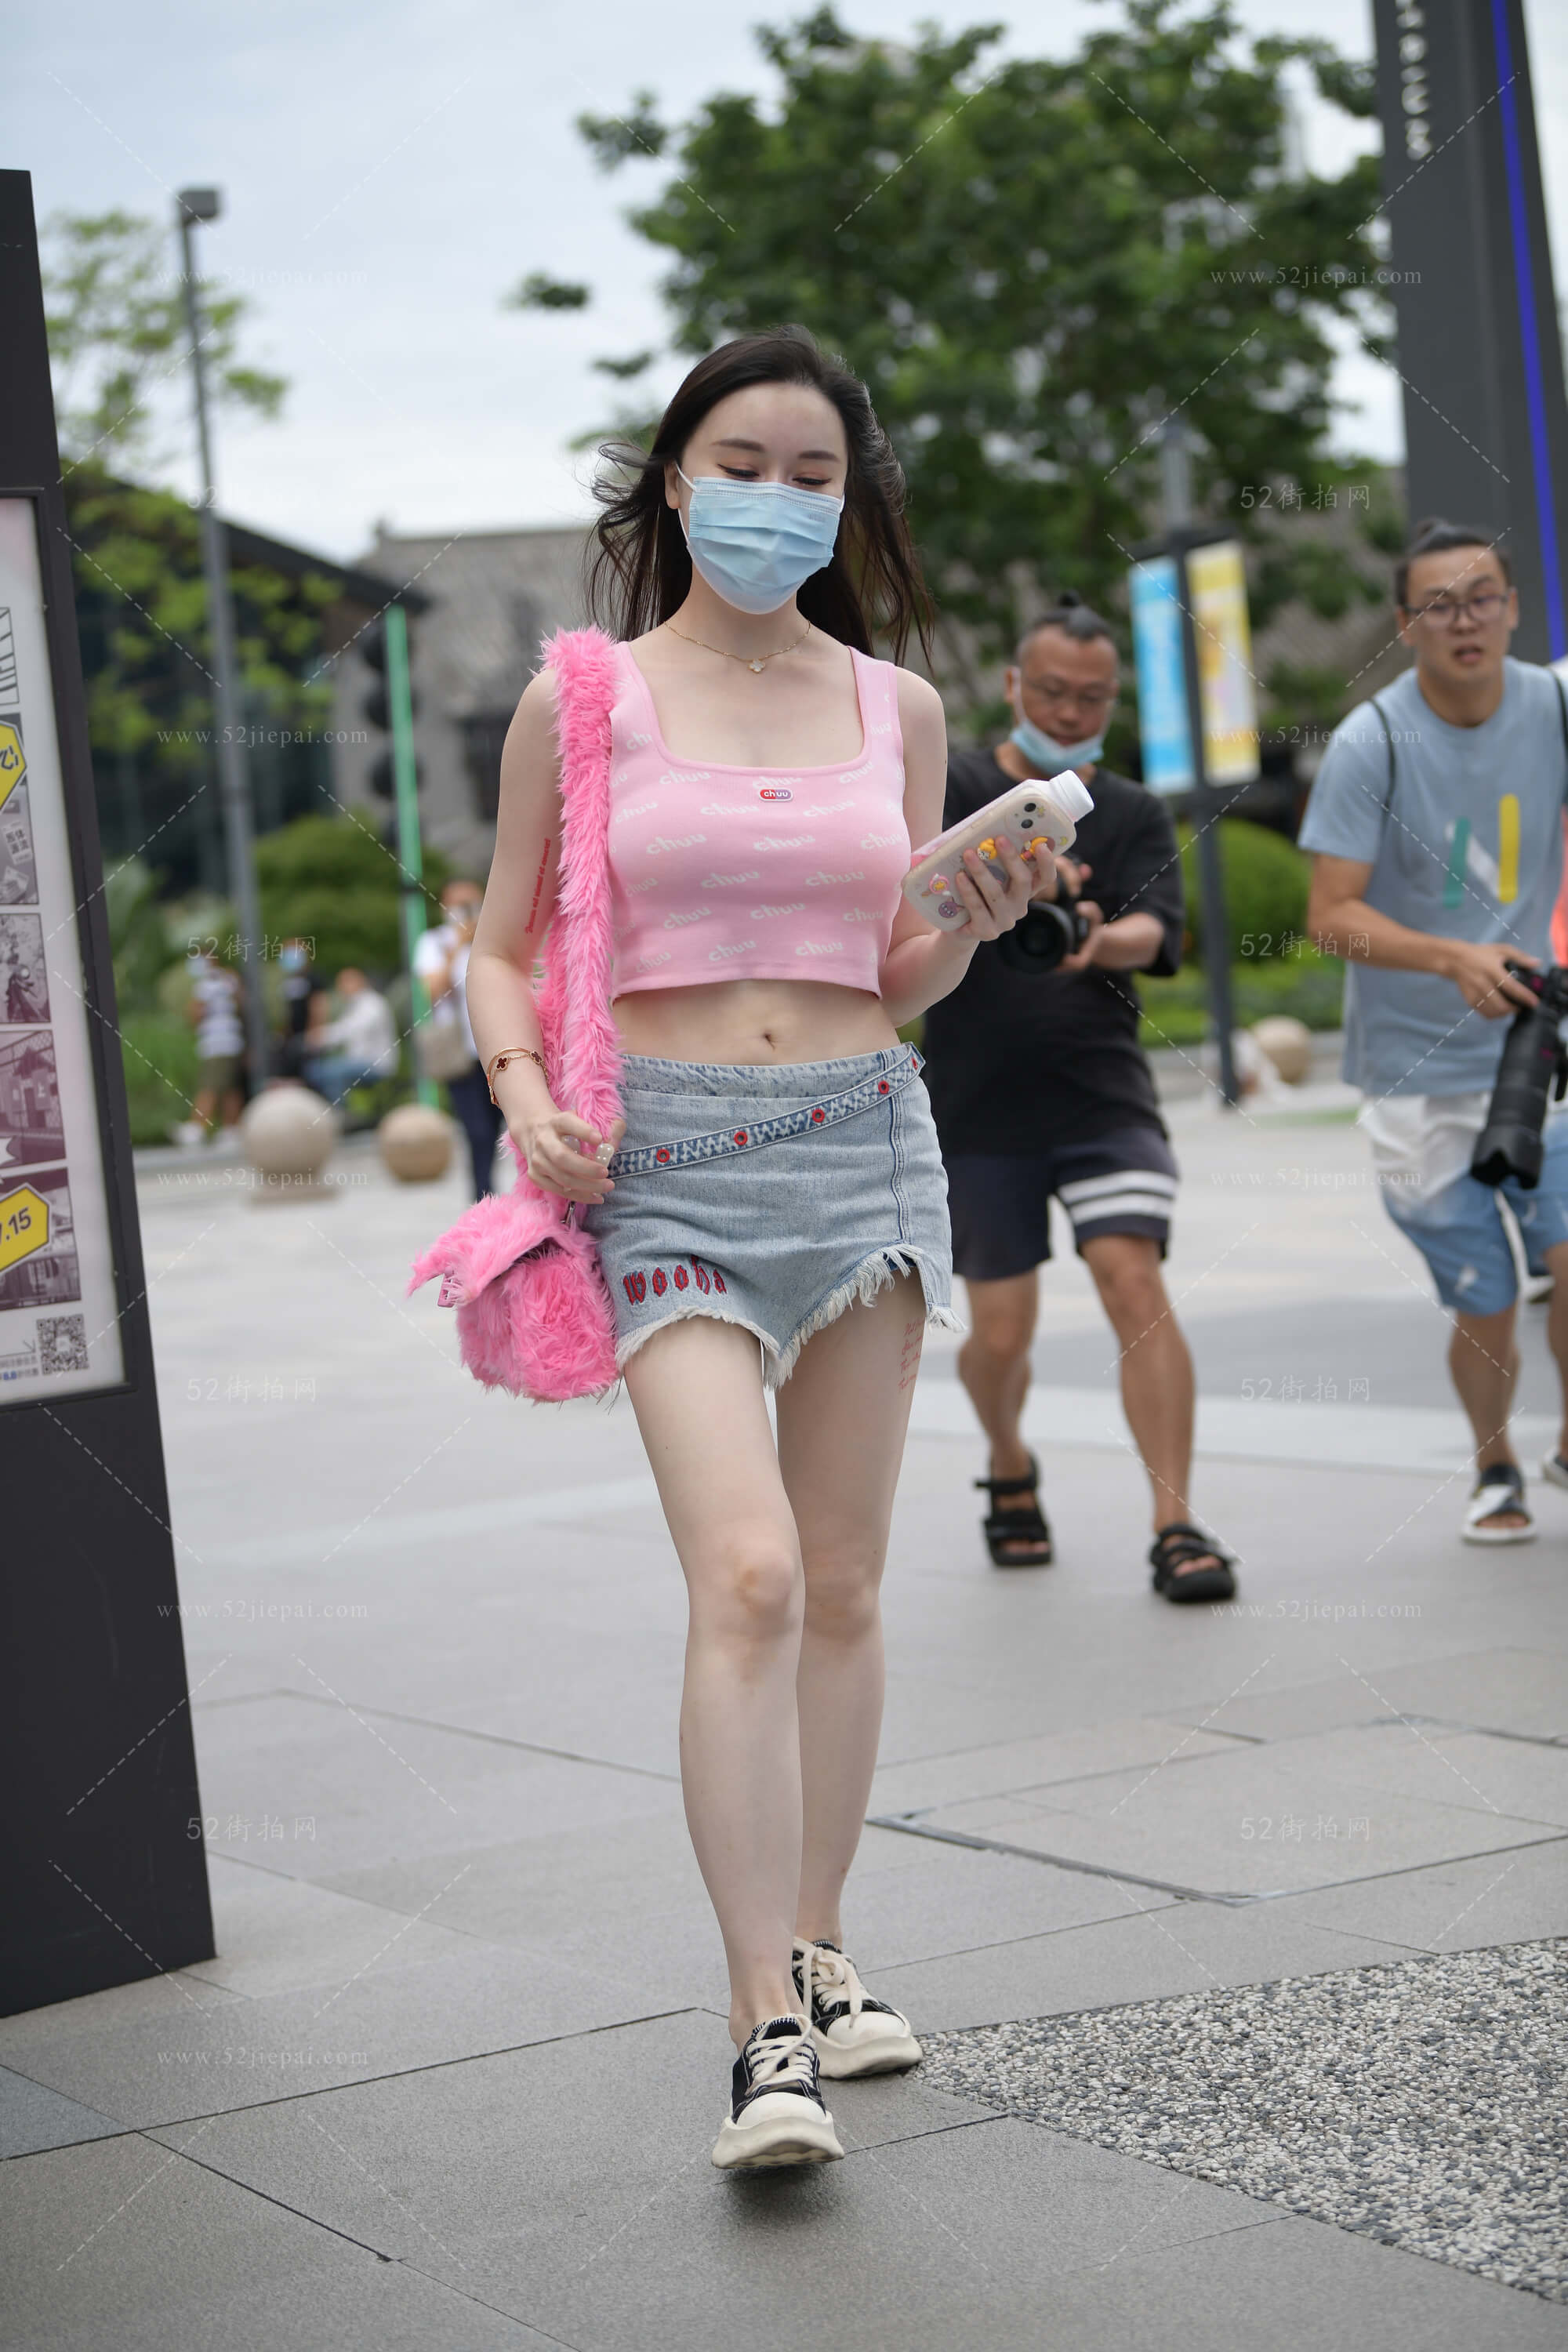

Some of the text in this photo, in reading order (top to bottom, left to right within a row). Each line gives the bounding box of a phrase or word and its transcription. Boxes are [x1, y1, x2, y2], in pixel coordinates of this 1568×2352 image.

[659, 769, 711, 785] chuu
[764, 789, 788, 798] chuu
[803, 800, 857, 817] chuu
[647, 833, 706, 854] chuu
[753, 834, 815, 852] chuu
[701, 871, 760, 888] chuu
[805, 871, 866, 887] chuu
[664, 907, 712, 929] chuu
[750, 902, 806, 920] chuu
[843, 906, 884, 923] chuu
[708, 940, 757, 961] chuu
[795, 940, 844, 956] chuu
[0, 1206, 31, 1245] .15
